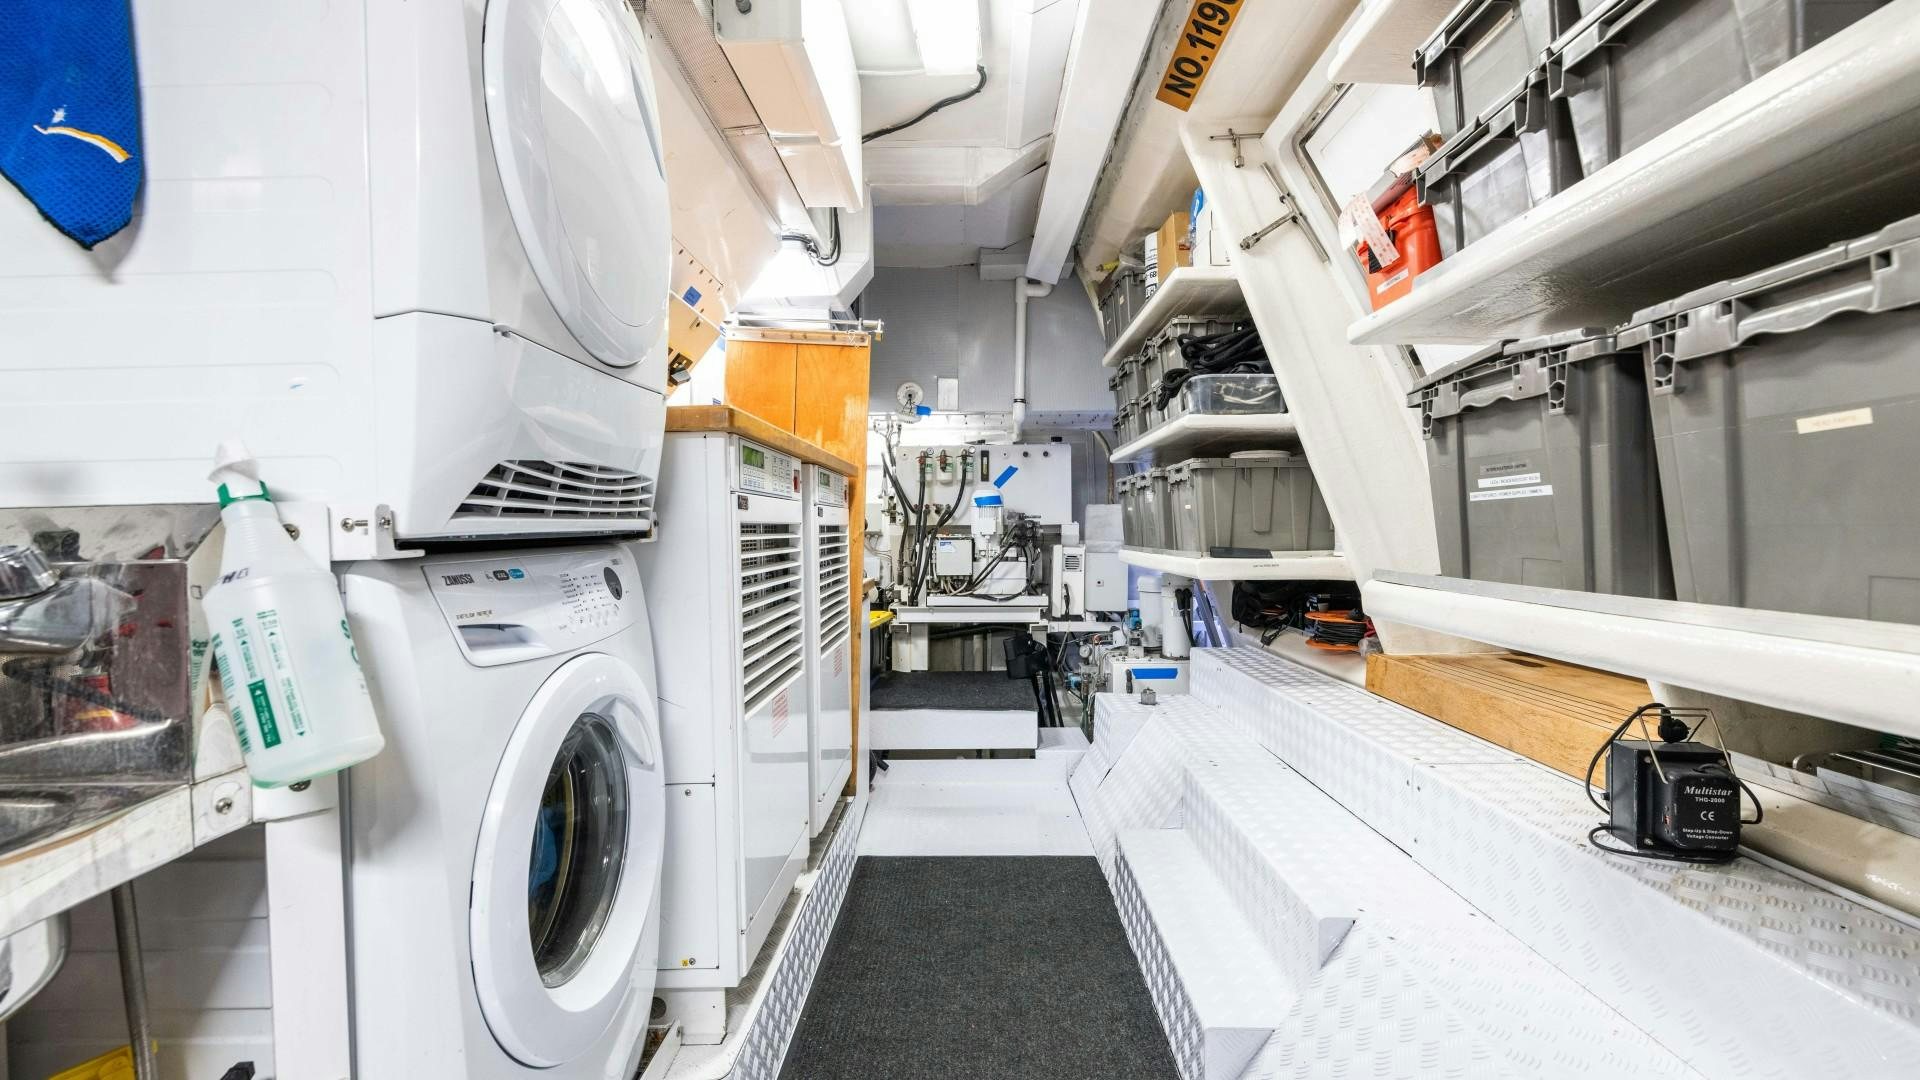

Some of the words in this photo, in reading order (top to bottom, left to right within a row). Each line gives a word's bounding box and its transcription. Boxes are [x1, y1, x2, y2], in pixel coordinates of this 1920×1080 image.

[1164, 0, 1236, 98] NO.119
[442, 574, 475, 586] ZANUSSI
[1684, 786, 1733, 796] Multistar
[1700, 811, 1715, 821] CE
